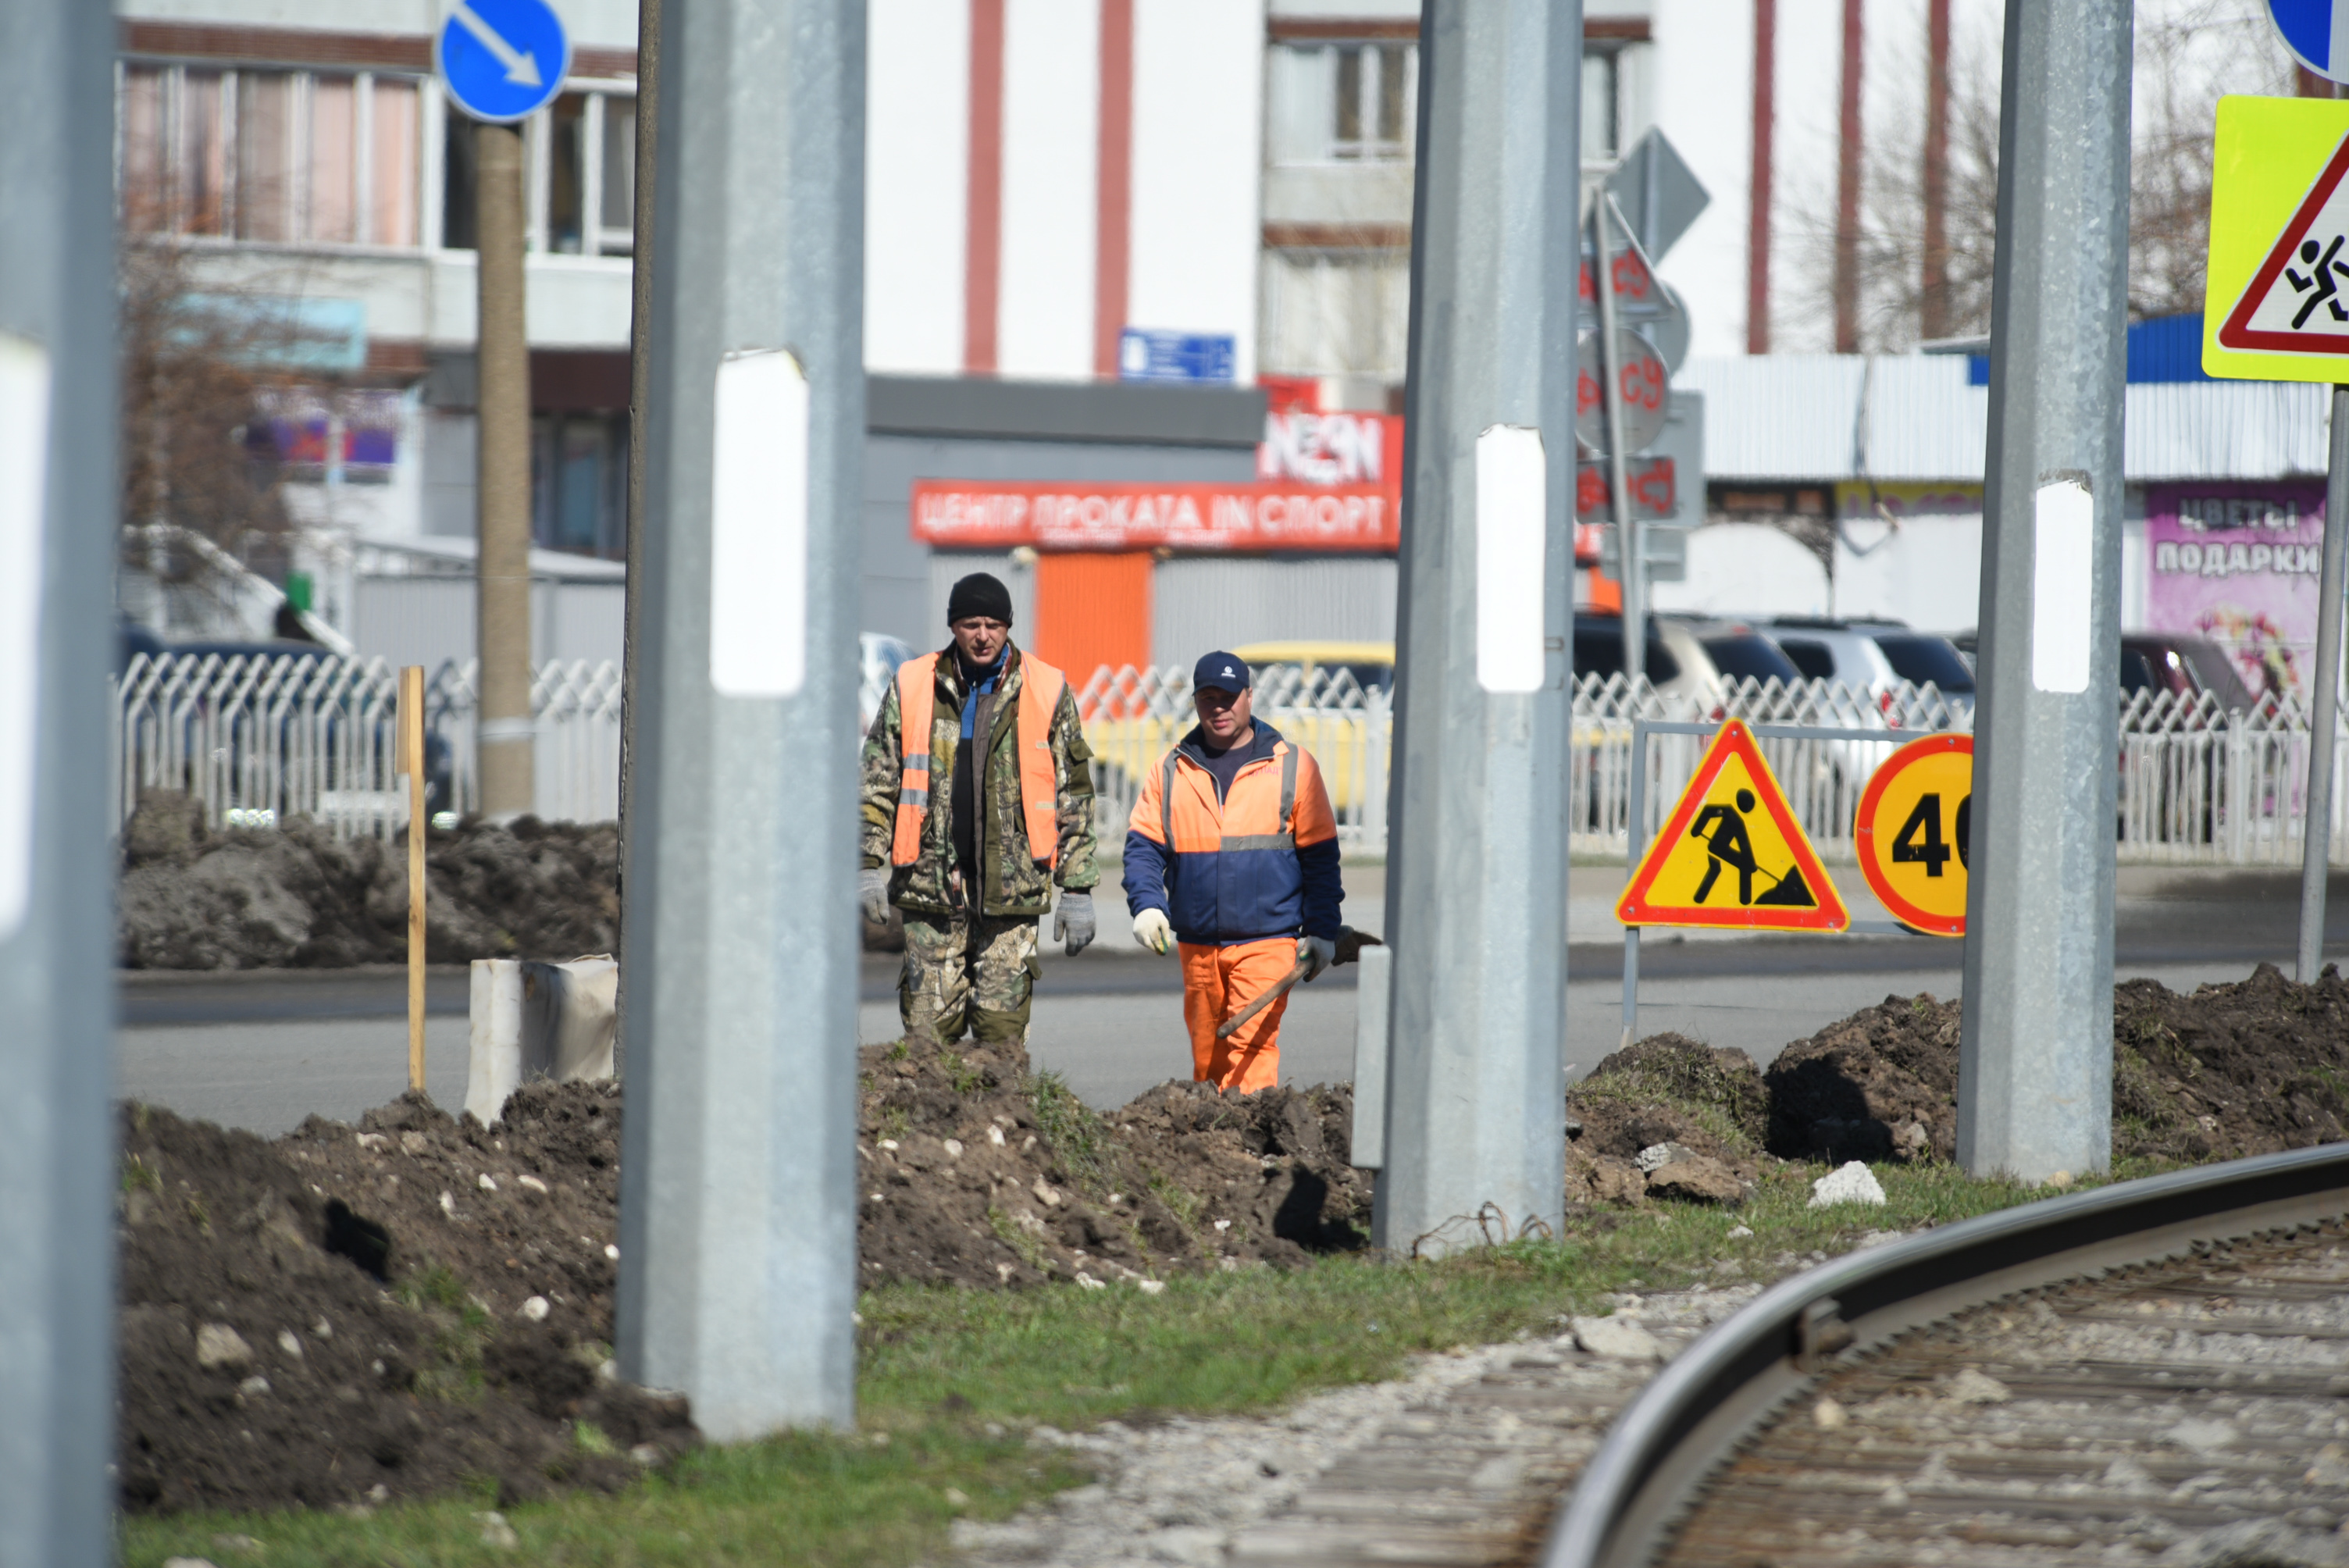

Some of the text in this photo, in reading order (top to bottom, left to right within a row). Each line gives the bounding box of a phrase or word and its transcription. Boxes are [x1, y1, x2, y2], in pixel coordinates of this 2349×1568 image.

[916, 492, 1028, 533] ЦЕНТР
[1031, 494, 1203, 530] ПРОКАТА
[1256, 494, 1386, 535] СПОРТ
[2178, 497, 2298, 533] ЦВЕТЫ
[2155, 541, 2322, 579] ПОДАРКИ
